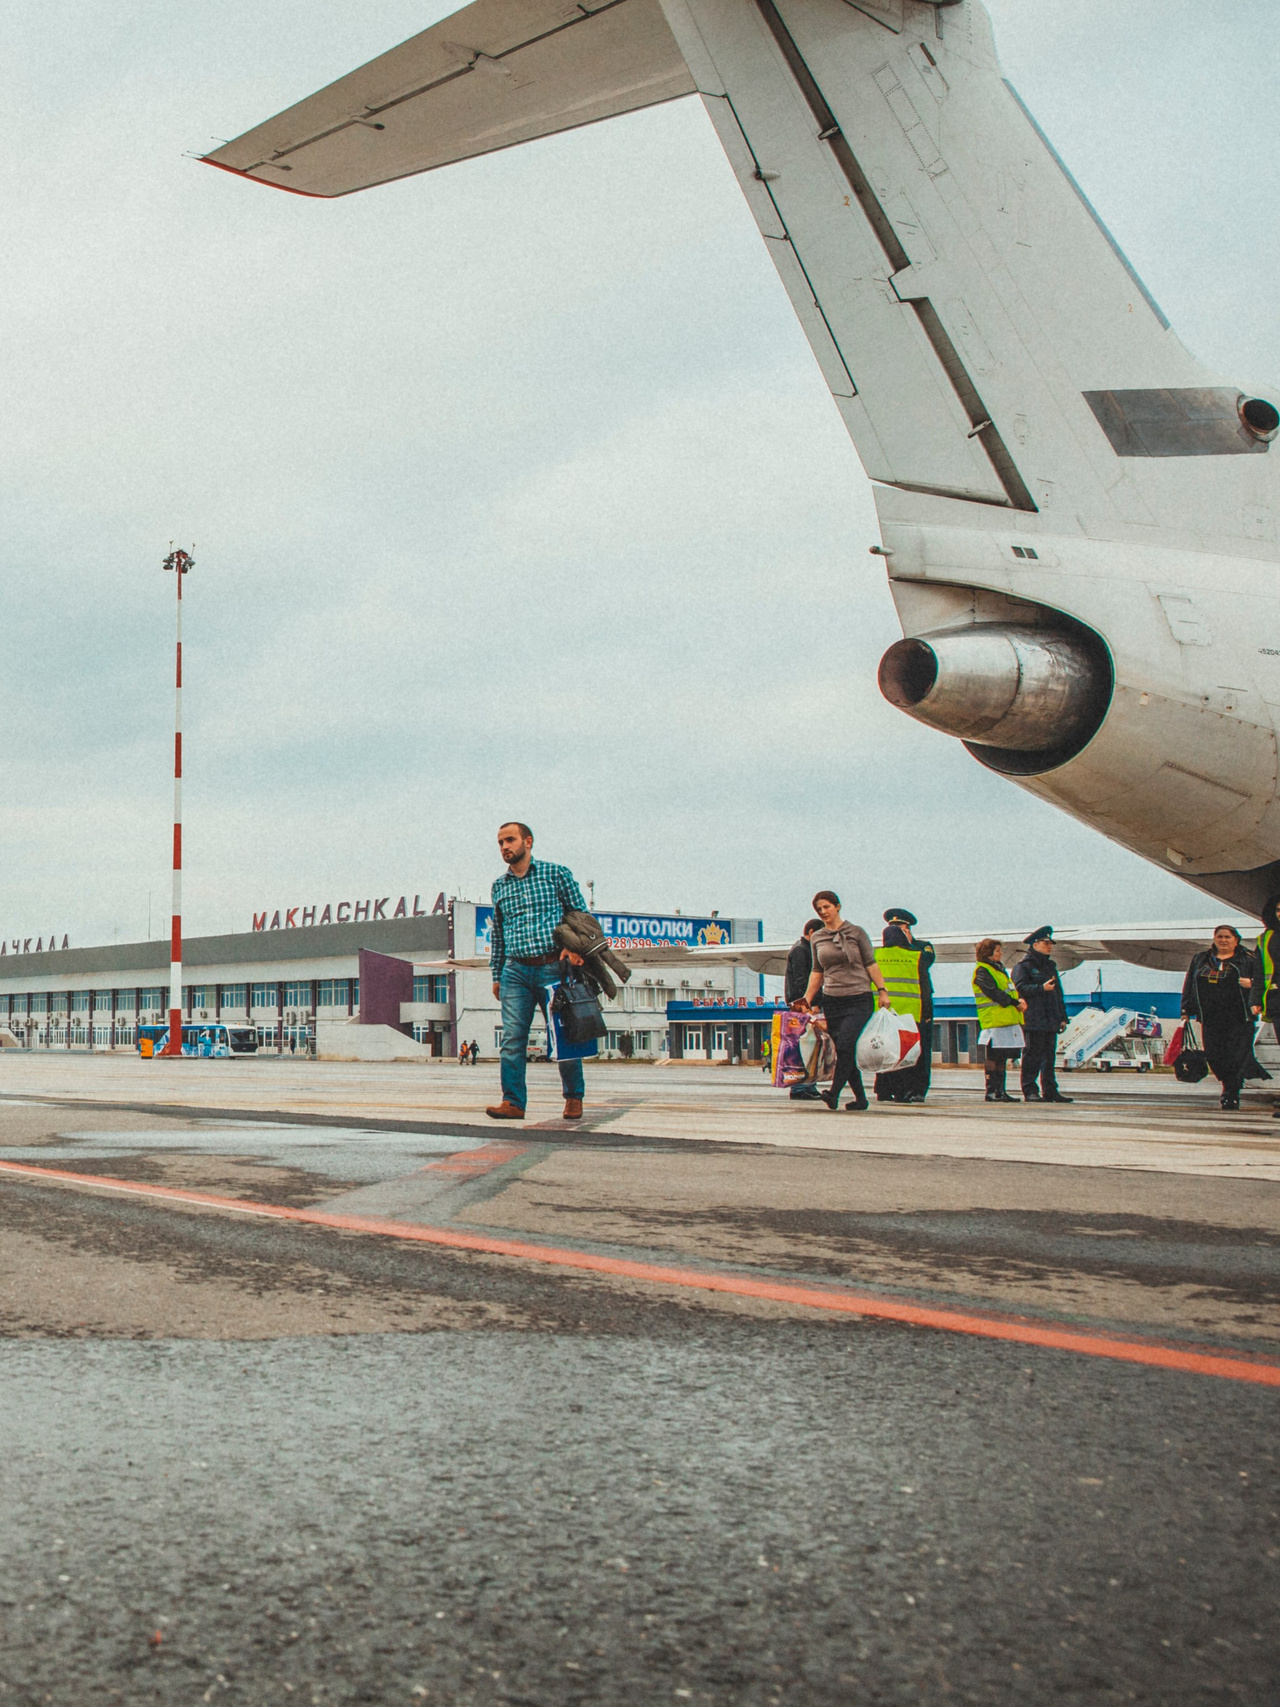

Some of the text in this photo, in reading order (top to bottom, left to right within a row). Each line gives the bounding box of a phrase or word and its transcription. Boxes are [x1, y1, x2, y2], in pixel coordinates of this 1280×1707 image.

[252, 892, 446, 932] MAKHACHKALA
[617, 919, 693, 938] ПОТОЛКИ
[692, 996, 748, 1008] ВЫХОД
[755, 996, 764, 1006] В
